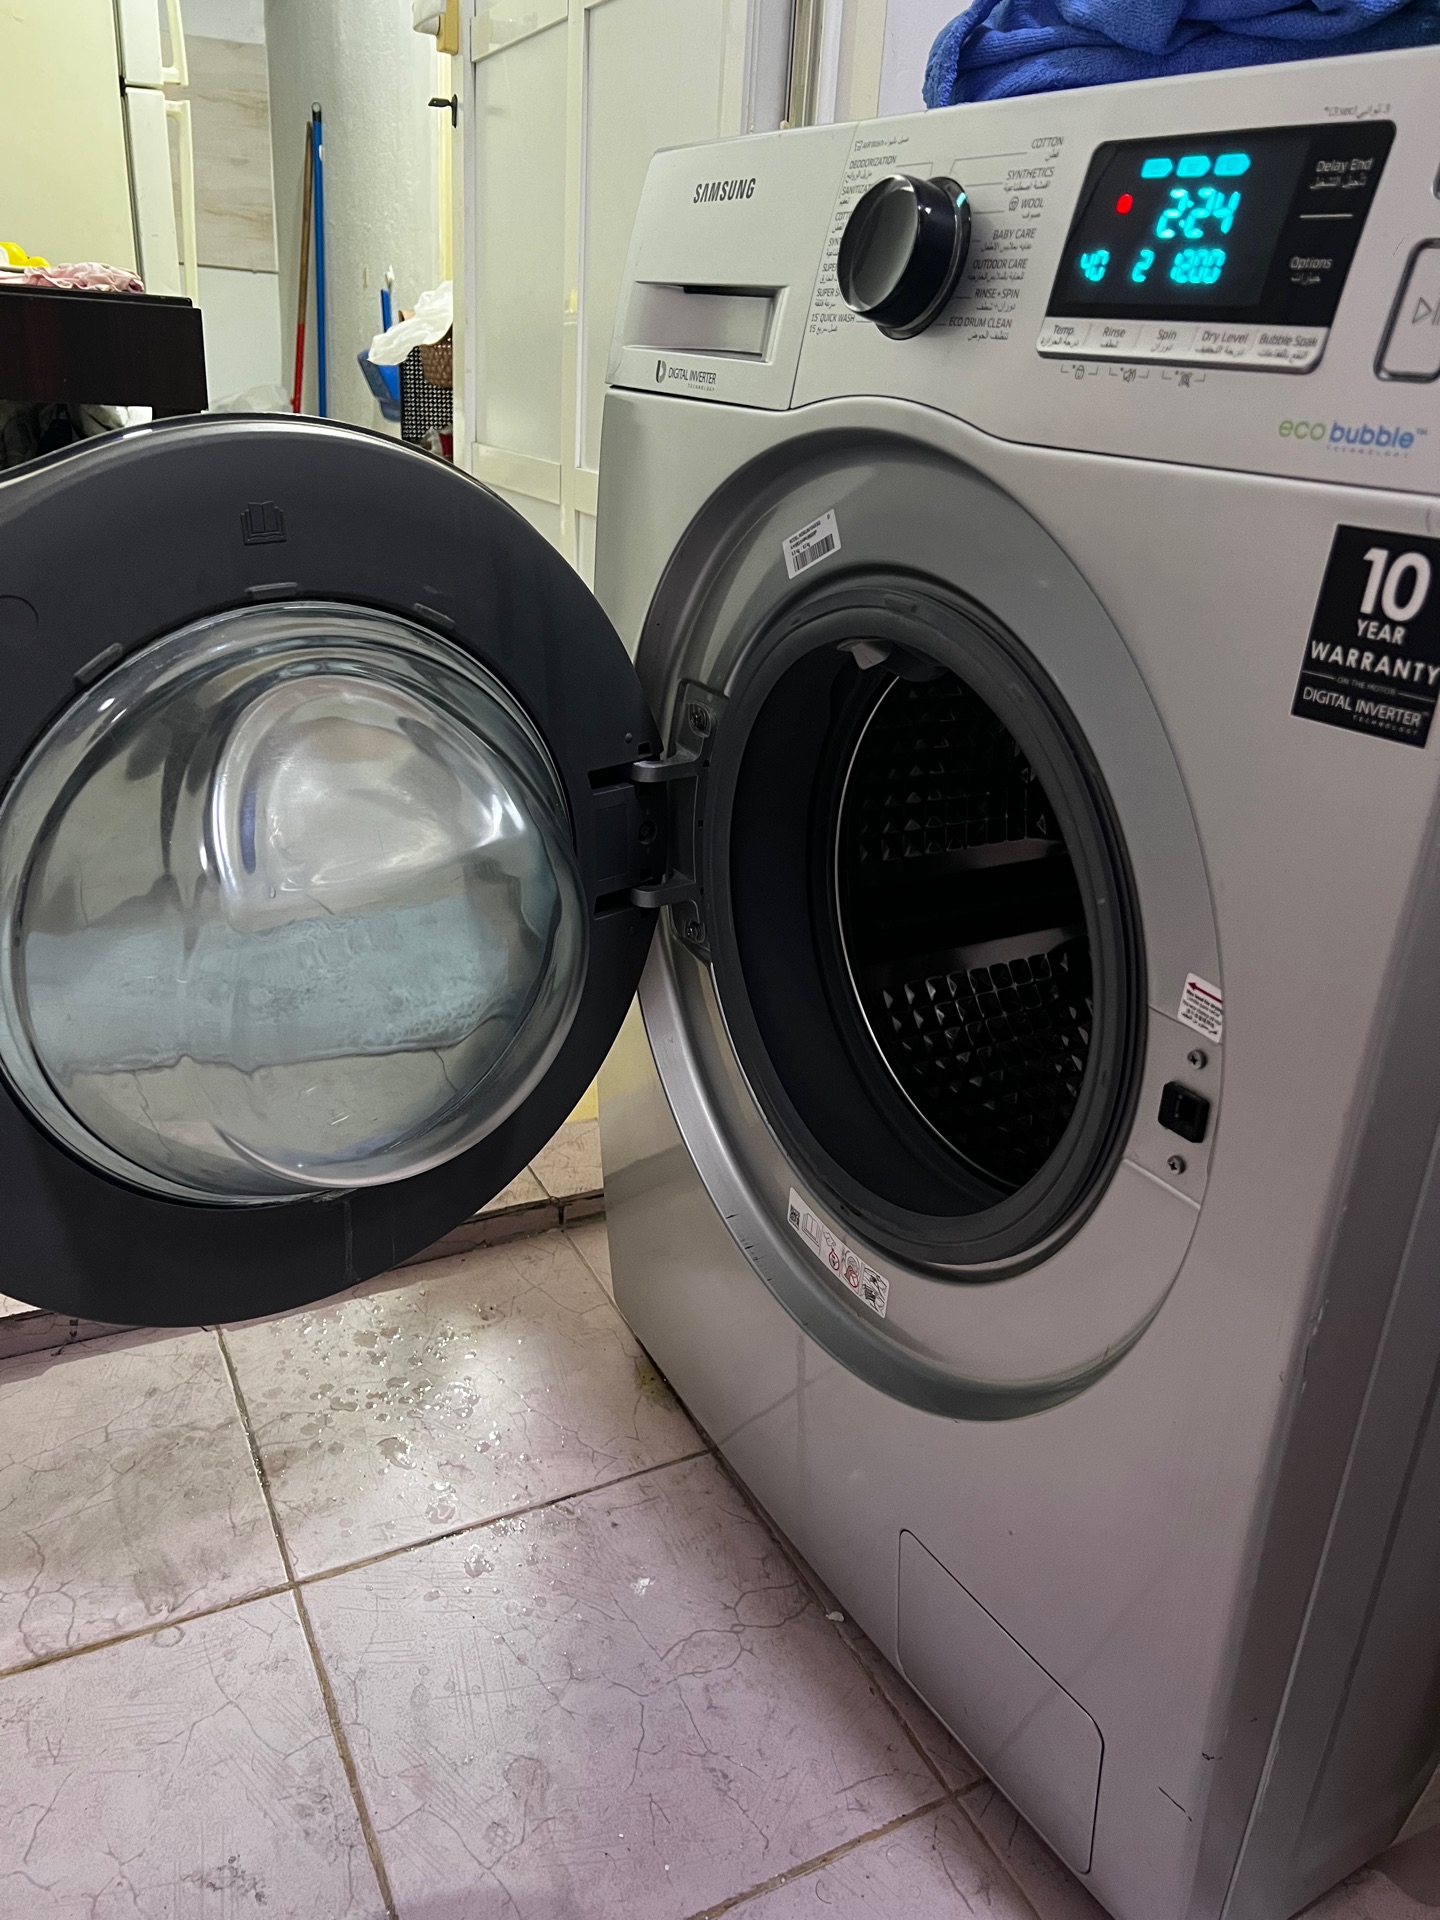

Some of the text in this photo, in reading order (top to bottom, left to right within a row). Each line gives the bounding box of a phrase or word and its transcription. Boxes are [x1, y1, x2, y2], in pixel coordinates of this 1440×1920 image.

[1031, 136, 1064, 149] COTTON
[849, 155, 897, 169] DEODORIZATION
[1316, 158, 1373, 173] Delay End
[1006, 166, 1055, 180] SYNTHETICS
[693, 178, 756, 203] SAMSUNG
[841, 184, 872, 196] SANITIZAT
[1021, 197, 1044, 209] WOOL
[1156, 187, 1241, 239] 2:24
[992, 228, 1037, 240] BABY CARE
[972, 258, 1028, 269] OUTDOOR CARE
[1080, 249, 1110, 282] 40
[1131, 249, 1155, 283] 2
[1169, 248, 1226, 284] 1200
[1290, 256, 1332, 270] Options
[974, 288, 997, 298] RINSE
[1001, 289, 1020, 299] SPIN
[820, 313, 837, 323] QUICK
[838, 313, 855, 322] WASH
[949, 316, 1013, 328] ECO DRUM CLEAN
[1102, 327, 1126, 338] Rinse
[1156, 329, 1177, 340] Spin
[1202, 331, 1249, 345] Dry Level
[1259, 334, 1318, 348] Bubble Soak
[668, 367, 717, 384] DIGITAL INVERTER
[1278, 420, 1326, 441] eco
[1329, 421, 1415, 449] bubble
[1360, 547, 1431, 622] 10
[1357, 619, 1406, 645] YEAR
[1311, 640, 1440, 685] WARRANTY
[1351, 679, 1366, 690] THE
[1303, 686, 1421, 727] DIGITAL INVERTER
[1352, 715, 1419, 736] TECHNOLOGY
